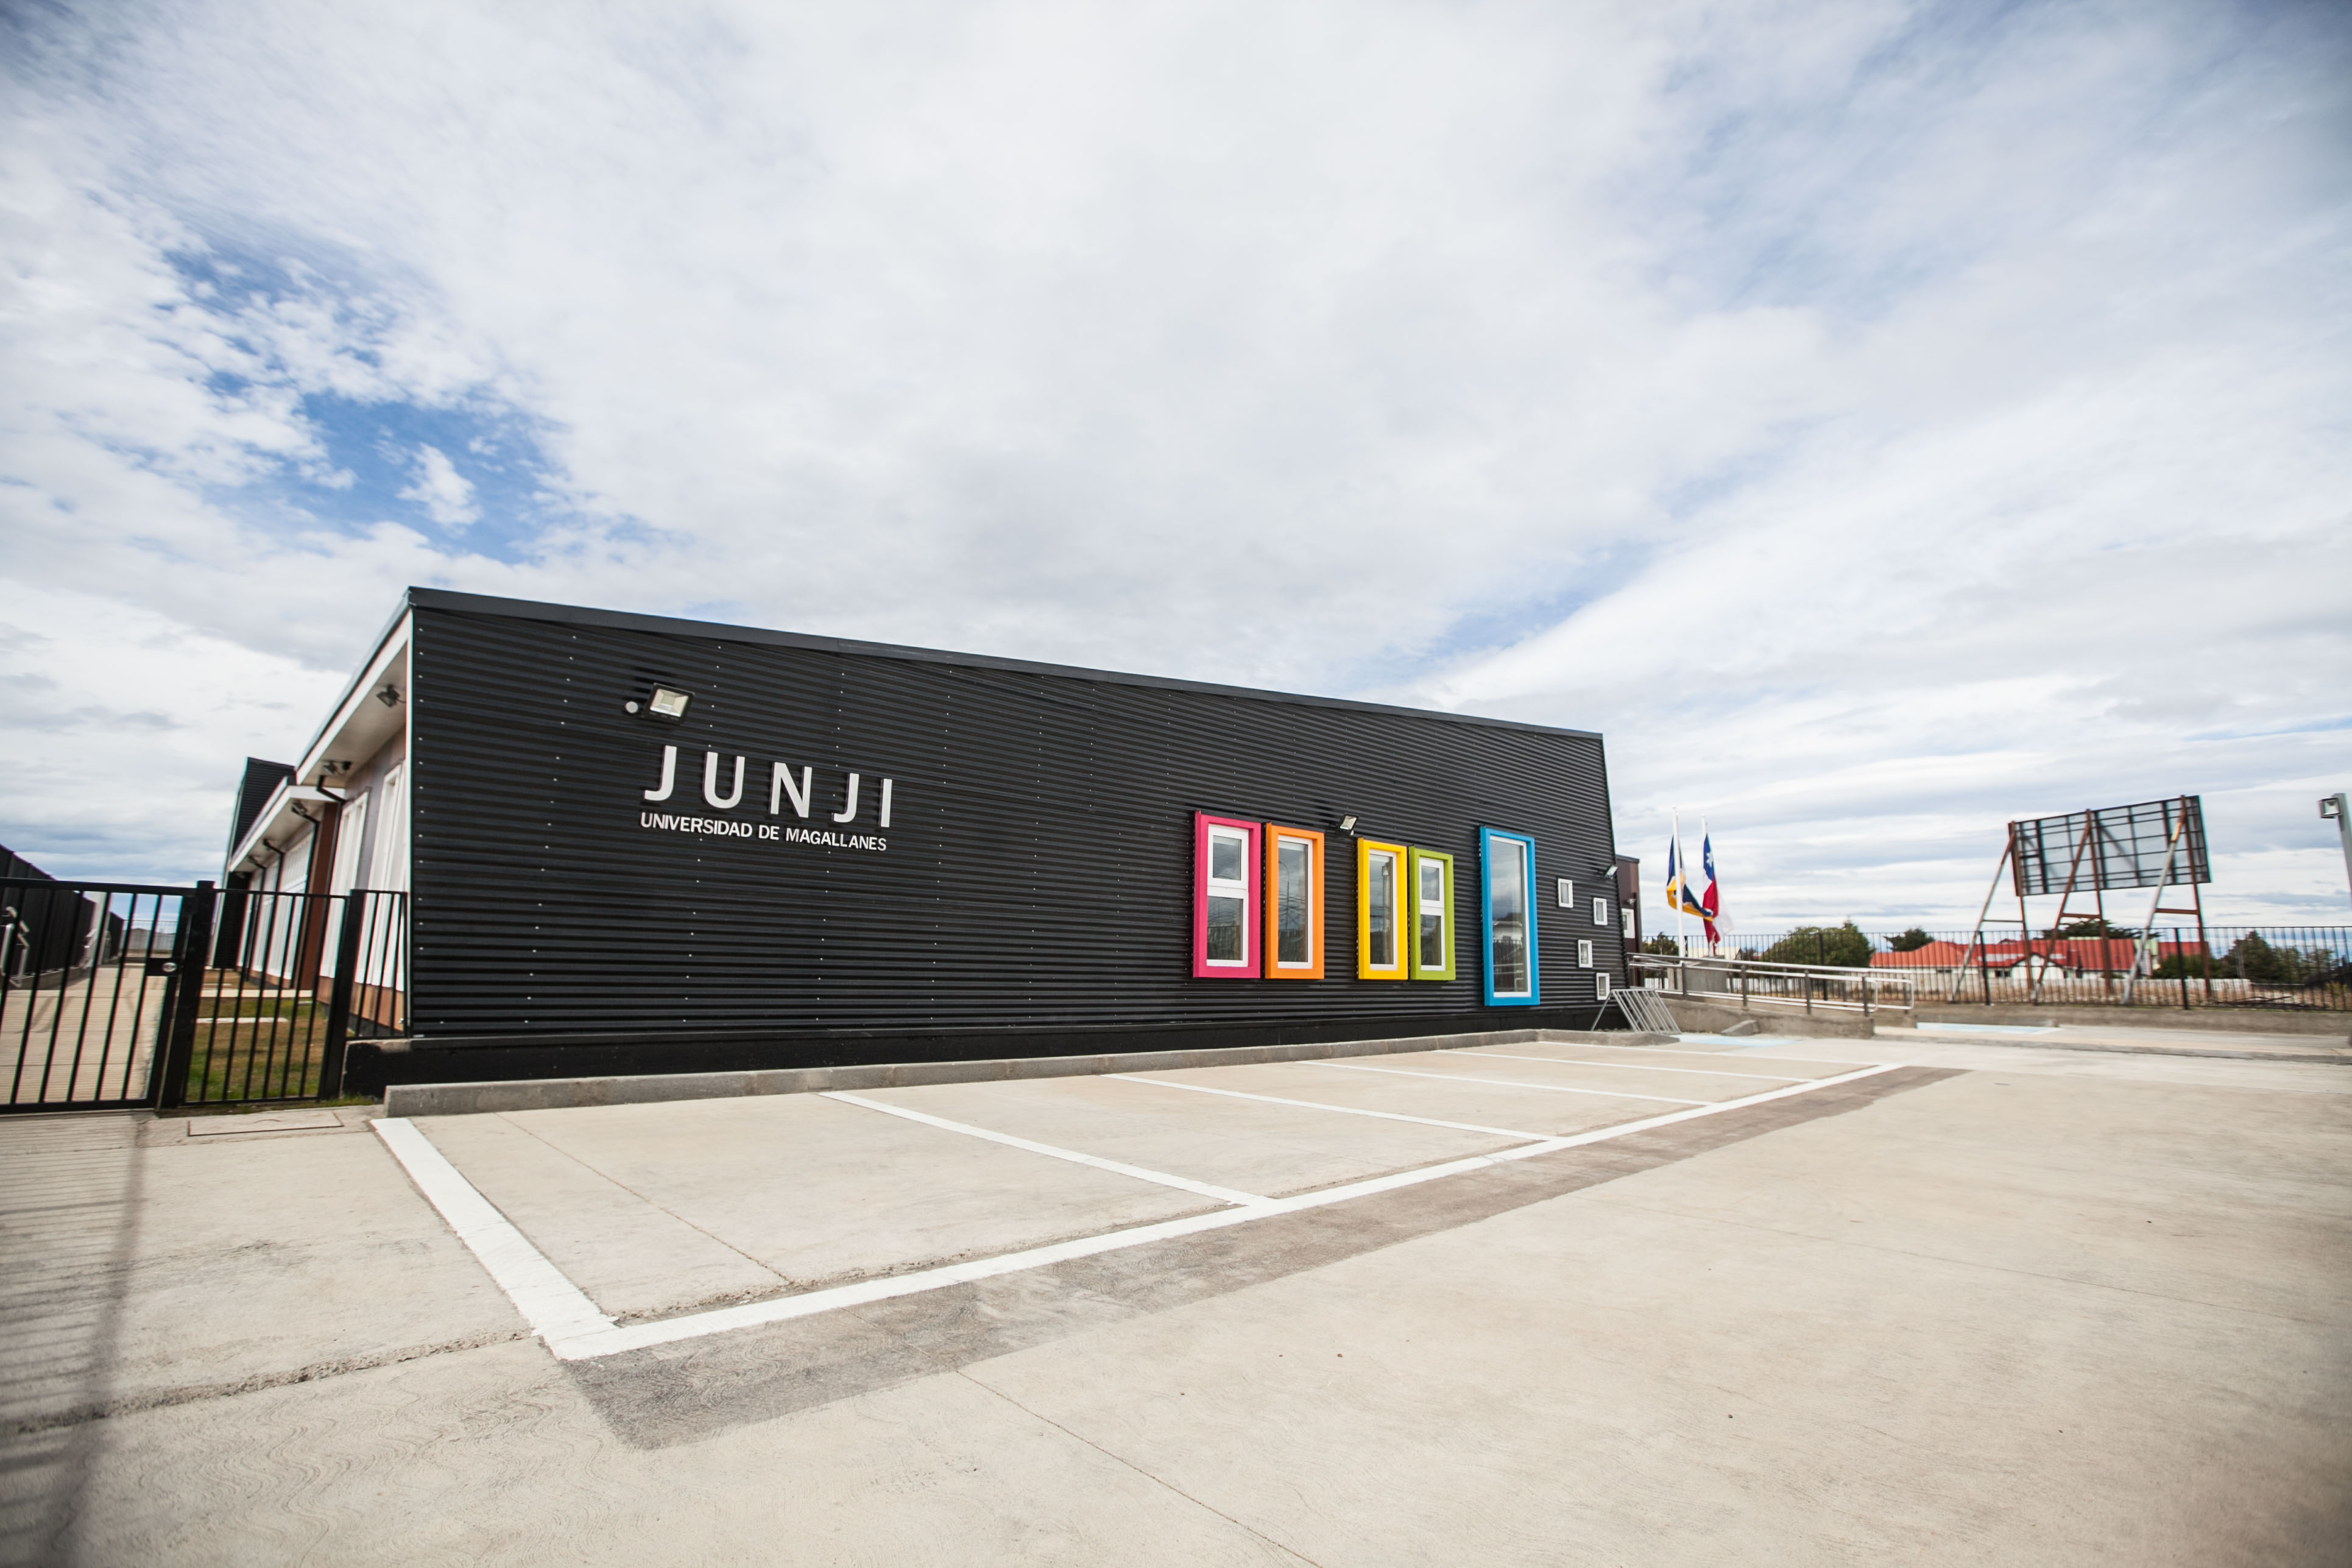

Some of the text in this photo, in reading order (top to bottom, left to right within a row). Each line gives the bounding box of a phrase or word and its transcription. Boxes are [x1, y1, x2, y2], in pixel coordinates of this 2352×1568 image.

[643, 745, 892, 828] JUNJI
[640, 812, 887, 852] UNIVERSIDAD DE MAGALLANES
